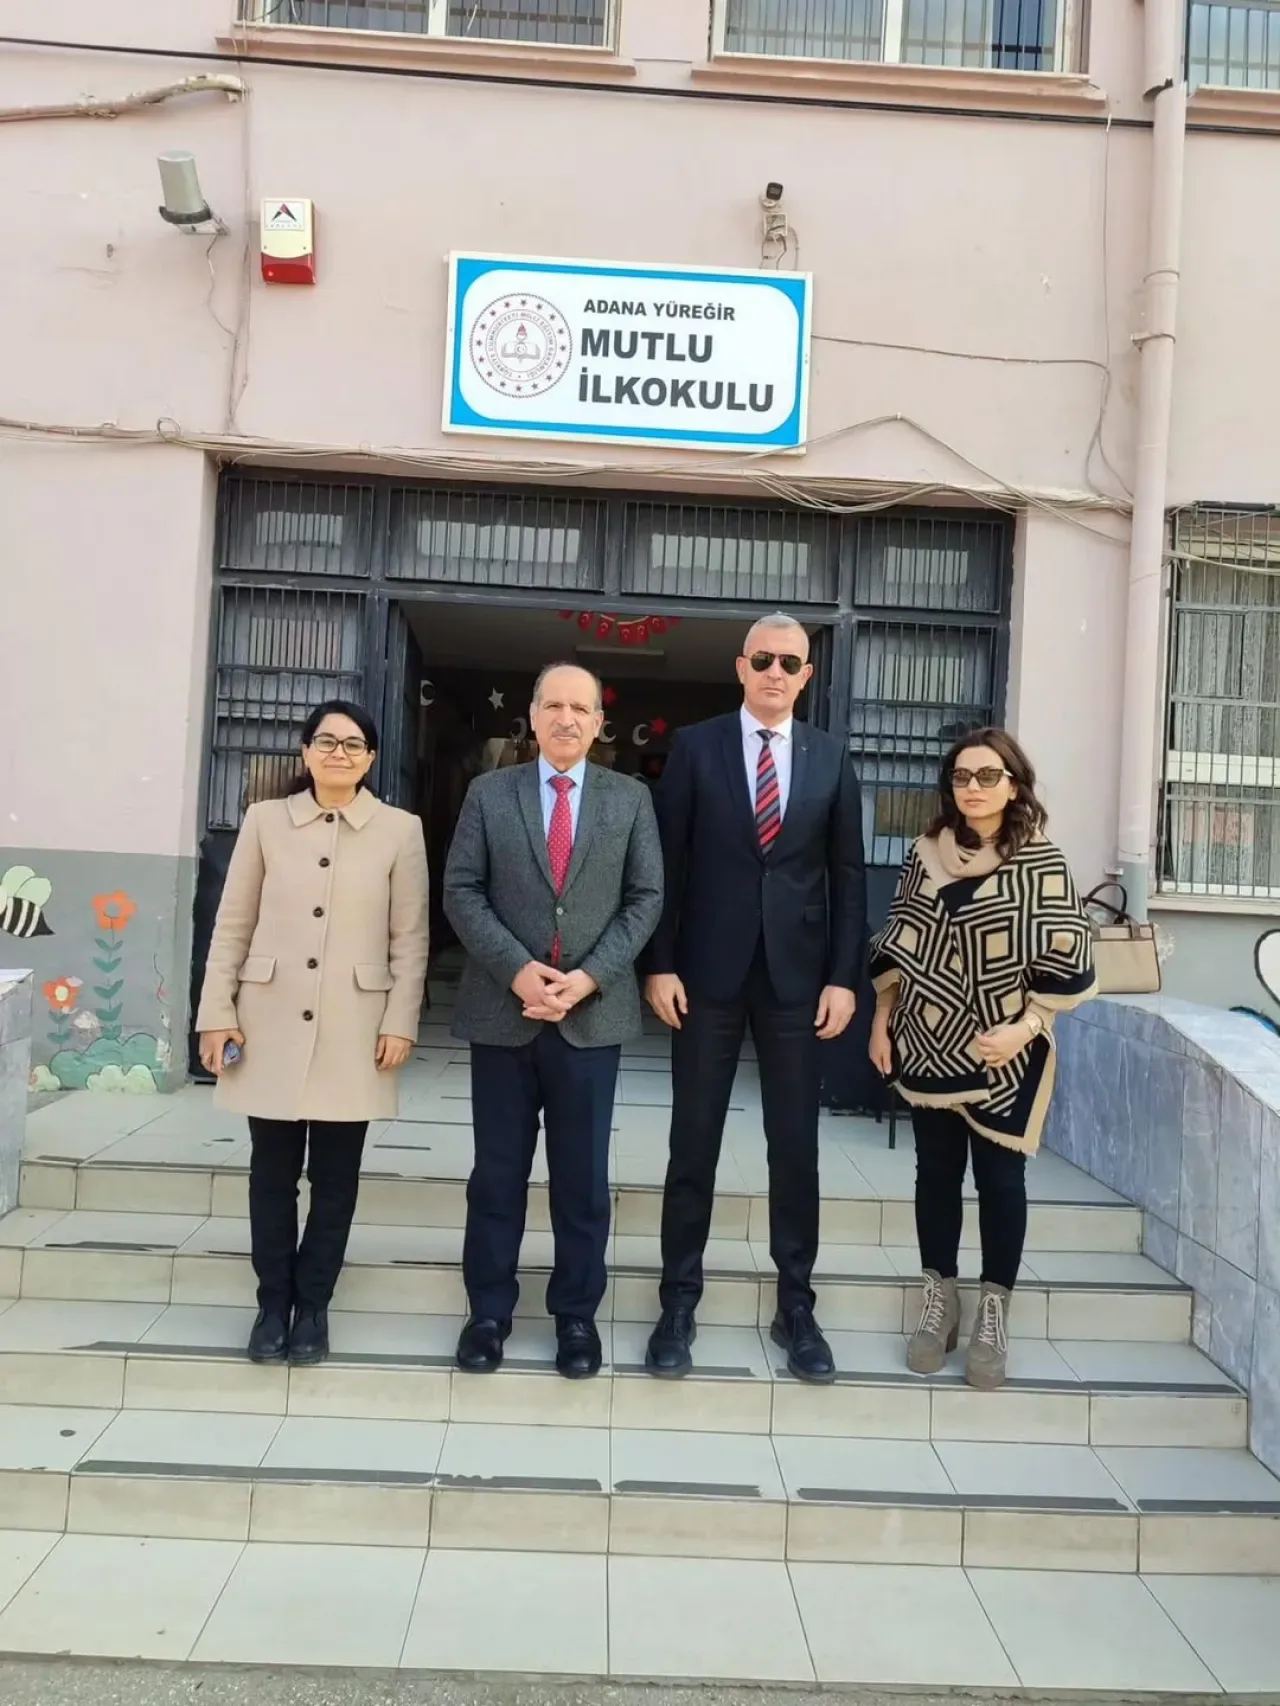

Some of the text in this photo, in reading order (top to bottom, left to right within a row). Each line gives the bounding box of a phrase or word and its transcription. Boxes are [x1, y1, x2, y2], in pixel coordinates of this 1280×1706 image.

[584, 299, 735, 321] ADANA YÜREĞİR
[581, 328, 713, 363] MUTLU
[578, 366, 774, 412] İLKOKULU
